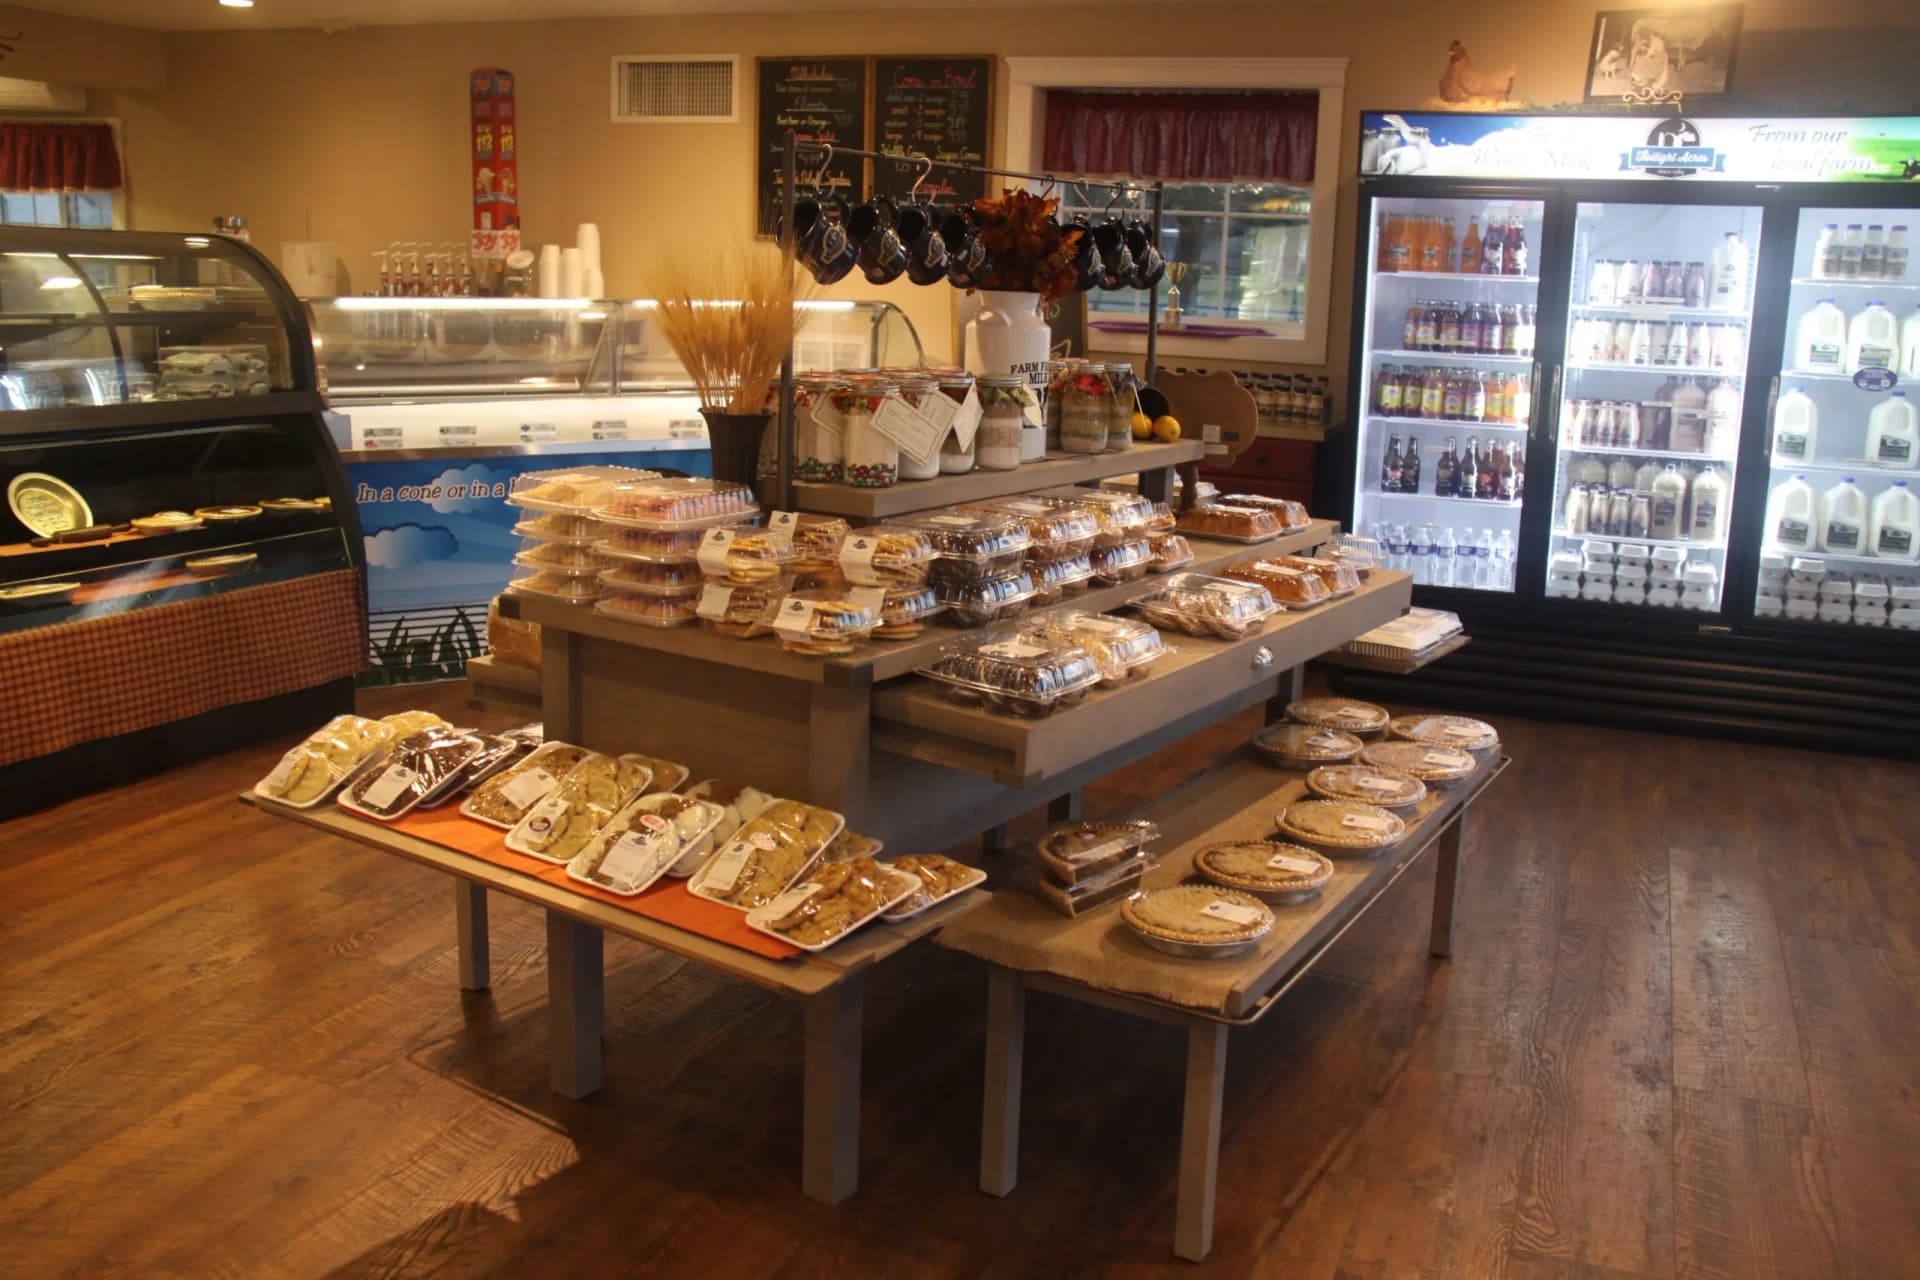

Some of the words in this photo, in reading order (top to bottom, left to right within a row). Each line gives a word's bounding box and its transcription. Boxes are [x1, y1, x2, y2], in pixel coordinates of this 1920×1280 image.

[1749, 124, 1806, 143] From
[1812, 130, 1848, 143] our
[1010, 362, 1039, 374] FARM
[357, 484, 377, 502] In
[380, 487, 393, 501] a
[398, 486, 441, 500] cone
[447, 485, 467, 498] or
[471, 481, 489, 498] in
[493, 484, 505, 497] a
